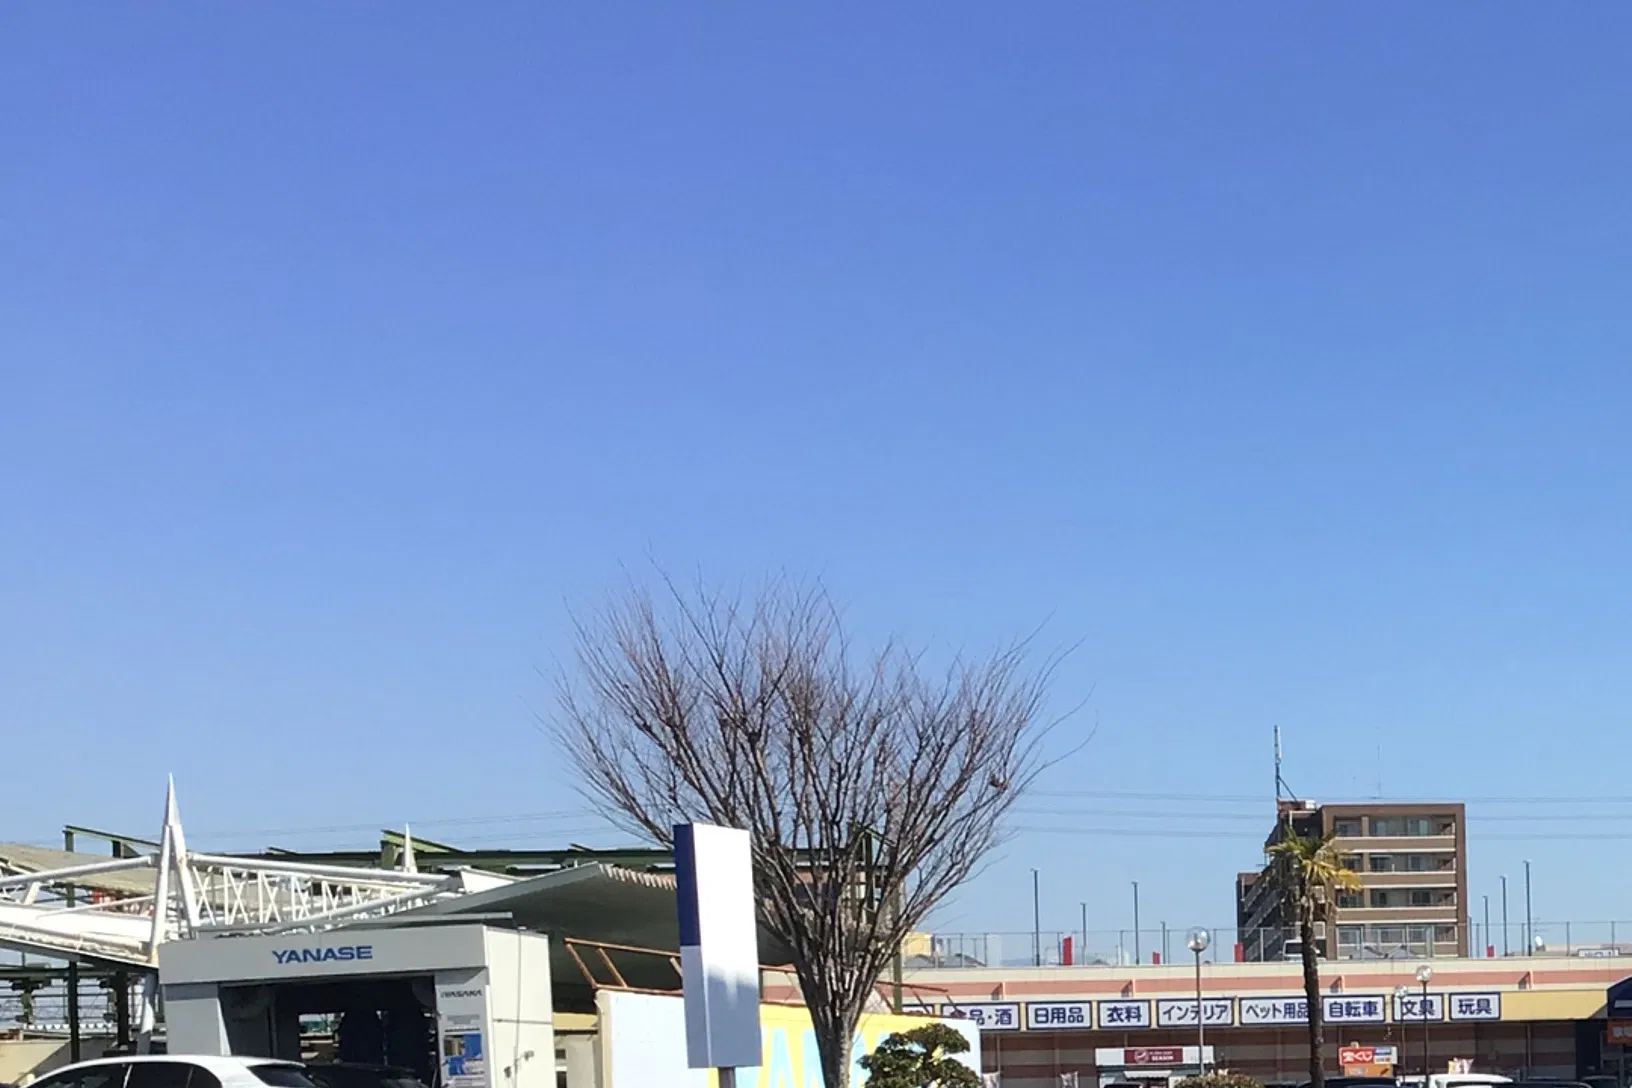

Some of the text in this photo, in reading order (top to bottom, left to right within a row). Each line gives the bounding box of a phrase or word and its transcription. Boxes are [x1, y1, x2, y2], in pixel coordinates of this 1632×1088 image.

[272, 945, 373, 964] YANASE
[1034, 1007, 1084, 1024] 日用品
[1107, 1005, 1142, 1024] 衣料
[1163, 1004, 1228, 1021] インテリア
[1245, 1003, 1309, 1020] ペット用品
[1329, 1001, 1380, 1018] 自転車
[1401, 999, 1435, 1017] 文具
[1458, 998, 1492, 1016] 玩具
